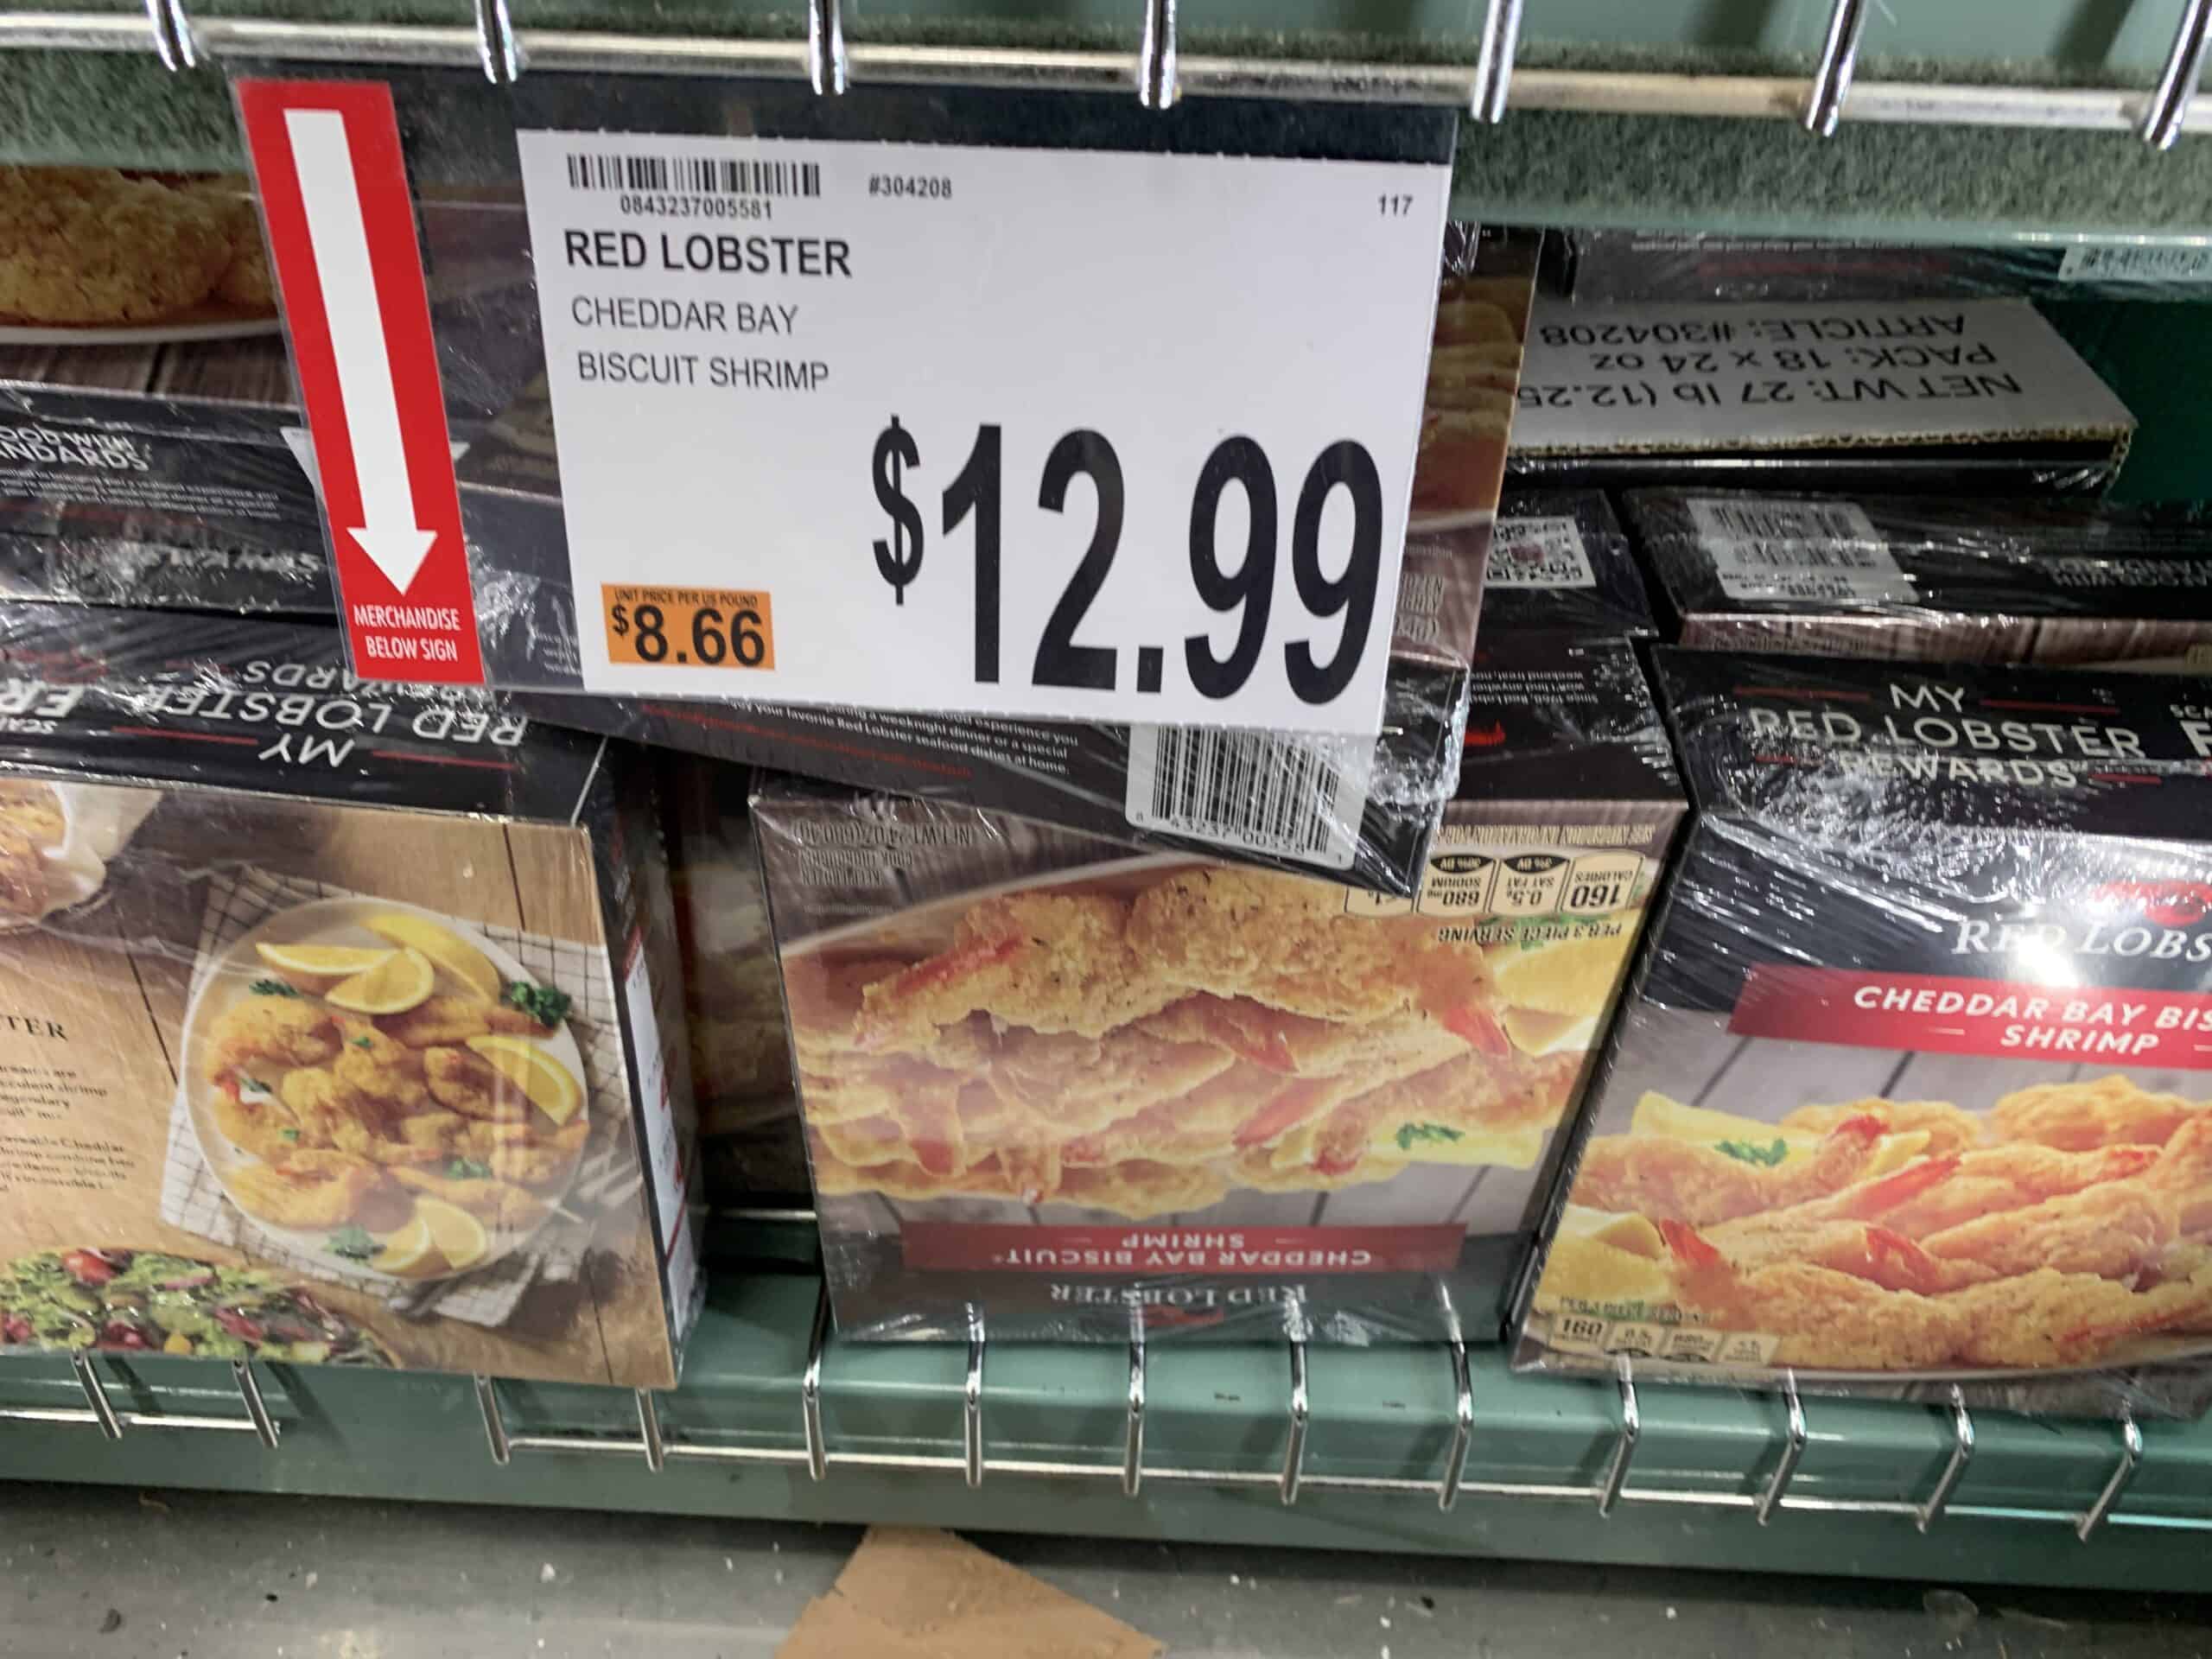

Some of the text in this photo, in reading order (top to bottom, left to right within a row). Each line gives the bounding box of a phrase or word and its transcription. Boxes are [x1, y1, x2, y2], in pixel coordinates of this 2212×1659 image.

[868, 176, 952, 199] #304208
[620, 196, 773, 219] 0843237005581
[1378, 194, 1414, 216] 117
[564, 229, 853, 278] RED LOBSTER
[571, 296, 799, 334] CHEDDAR BAY
[1539, 314, 1966, 346] ARTICLE: #304208
[1590, 352, 1645, 372] oz
[1661, 351, 1720, 375] 24
[1773, 347, 1832, 371] 18
[1851, 343, 1998, 369] PACK:
[577, 351, 830, 391] BISCUIT SHRIMP
[1672, 383, 1721, 406] lb
[1740, 381, 1796, 404] 27
[1916, 372, 2024, 401] NET
[871, 415, 1383, 705] $12.99
[642, 588, 674, 604] PRICE
[677, 590, 700, 605] PER
[701, 592, 717, 606] US
[720, 594, 759, 608] POUND
[353, 603, 461, 632] MERCHANDISE
[365, 634, 459, 663] BELOW SIGN
[612, 603, 766, 668] $8.66
[1889, 683, 1966, 713] MY
[145, 683, 529, 747] RED LOBSTER
[1749, 707, 2146, 760] RED LOBSTER
[258, 733, 355, 767] MY
[1838, 753, 2077, 788] REWARDS
[1570, 884, 1620, 908] 160
[1854, 985, 2054, 1020] CHEDDAR
[2062, 996, 2147, 1028] BAY
[1999, 1023, 2160, 1057] SHRIMP
[1122, 1232, 1245, 1249] SHRIMP
[1146, 1249, 1206, 1267] BAY
[1217, 1250, 1372, 1267] CHEDDAR
[1227, 1284, 1306, 1306] RED
